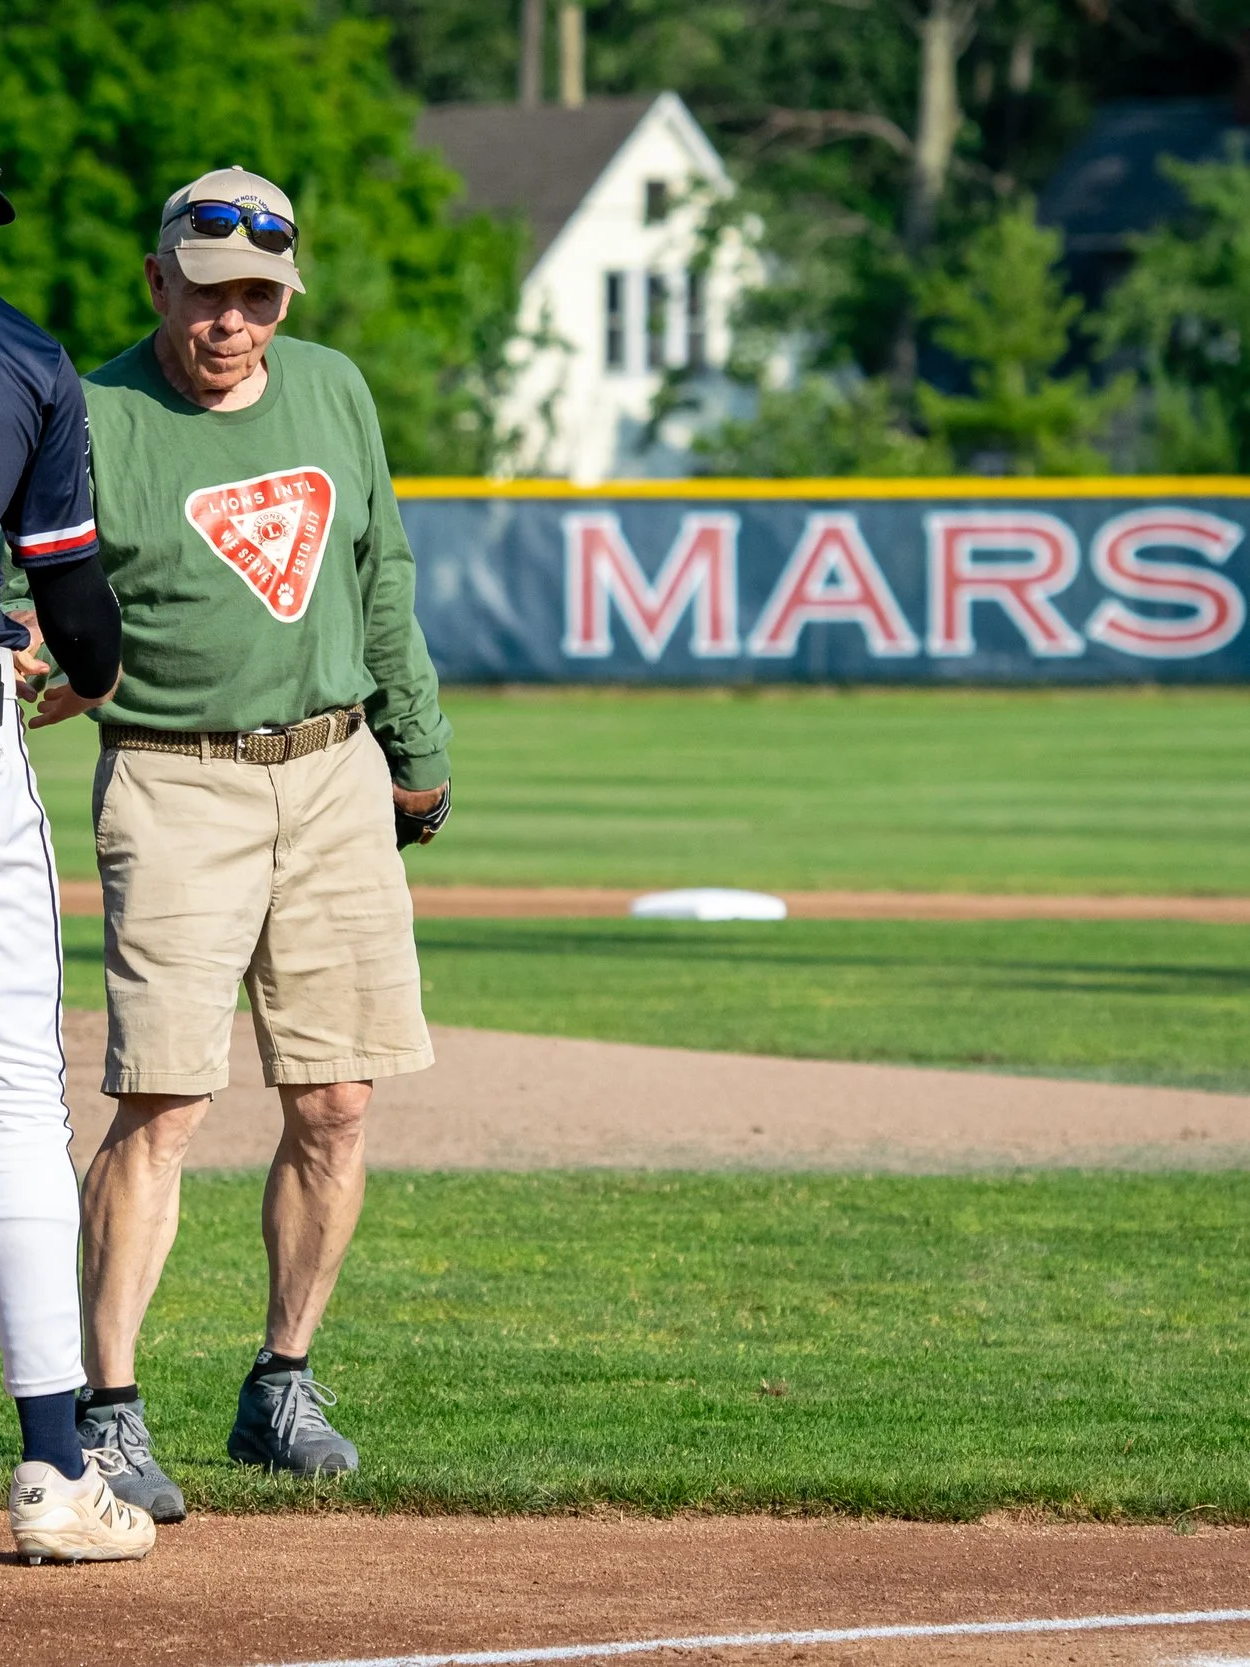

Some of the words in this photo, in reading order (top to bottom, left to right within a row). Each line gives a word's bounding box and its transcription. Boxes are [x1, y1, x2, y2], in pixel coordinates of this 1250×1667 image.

[258, 199, 270, 211] LIO
[208, 491, 265, 514] LIONS
[274, 480, 316, 499] INTL
[256, 513, 281, 525] LIONS
[265, 524, 280, 538] L
[220, 530, 240, 550] WE
[238, 549, 273, 584] SERVE
[293, 545, 311, 576] ESTD
[305, 511, 320, 538] 1917
[561, 506, 1246, 662] MARS
